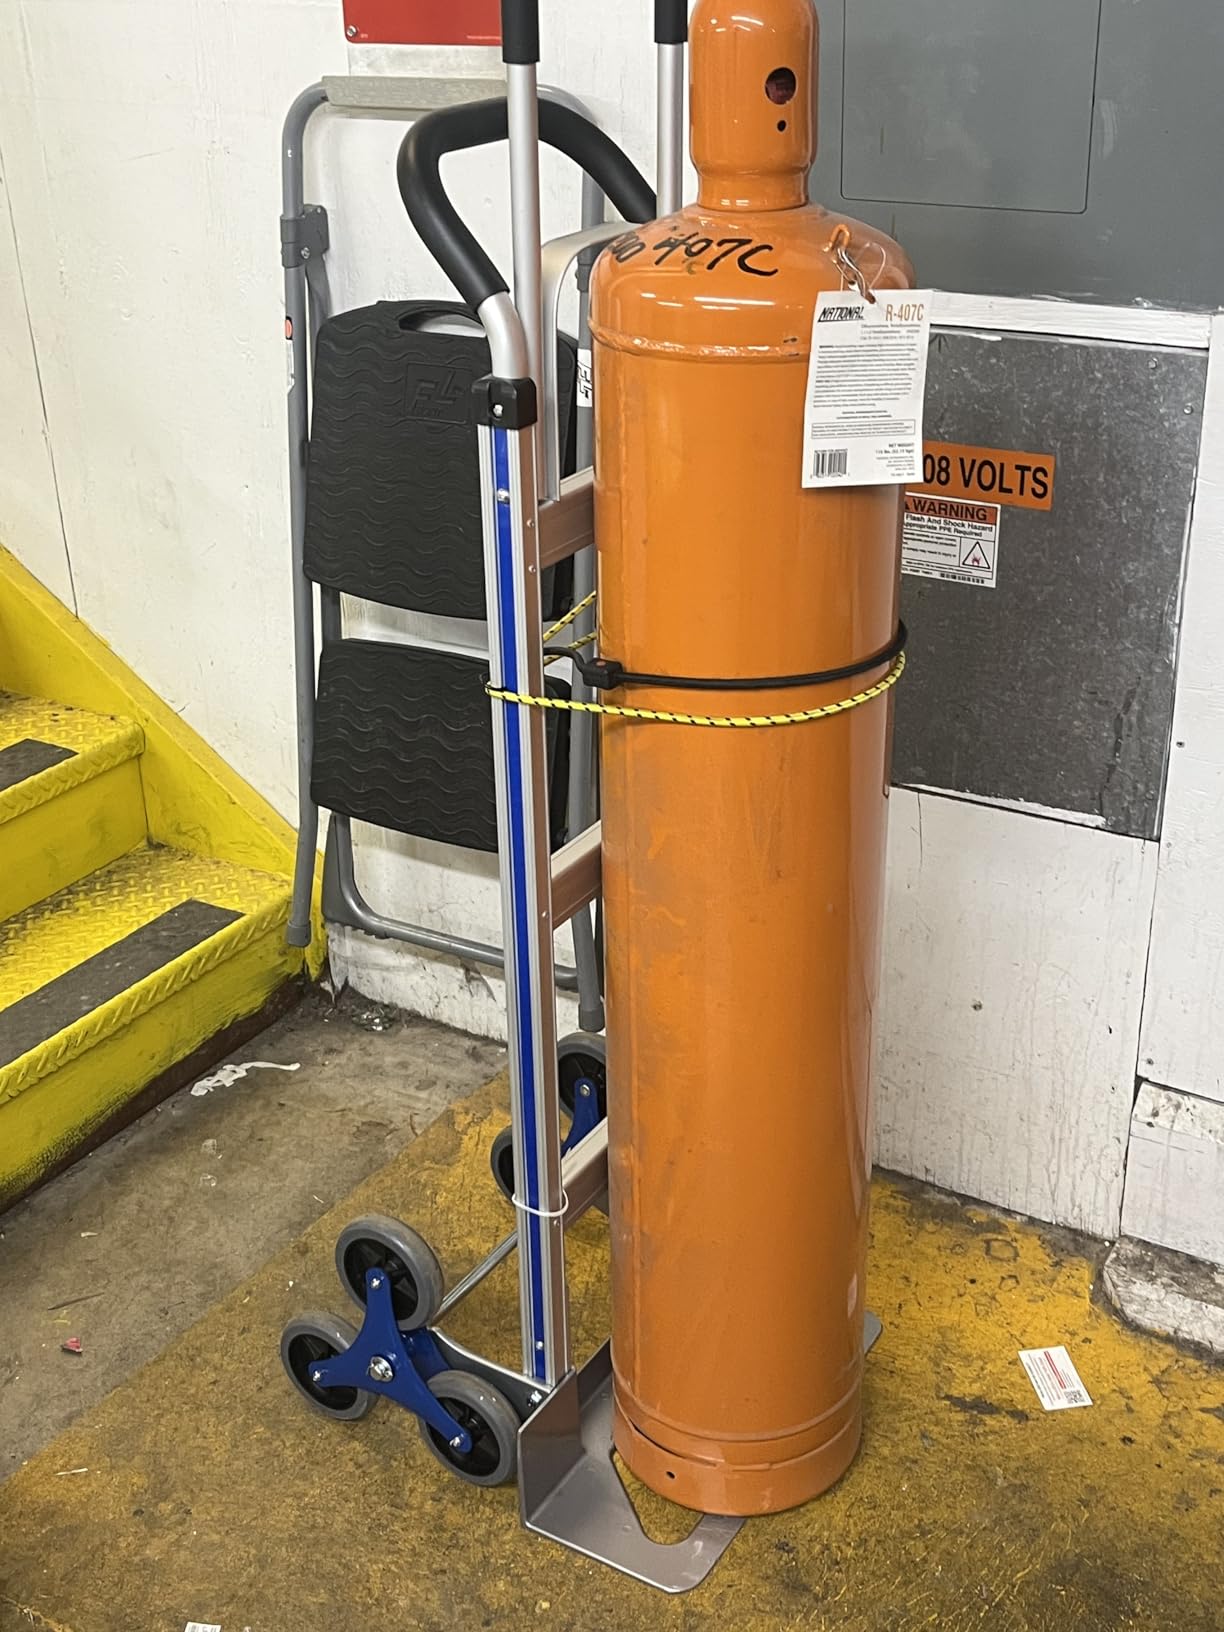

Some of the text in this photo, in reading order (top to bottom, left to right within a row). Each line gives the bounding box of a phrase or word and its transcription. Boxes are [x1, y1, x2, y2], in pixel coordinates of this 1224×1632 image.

[653, 232, 779, 276] 407C
[817, 306, 865, 323] NATIONAL
[885, 303, 925, 321] R-407C
[923, 453, 951, 486] 08
[959, 457, 1049, 500] VOLTS
[912, 498, 987, 520] WARNING
[904, 522, 937, 531] ppropriate
[939, 525, 952, 533] PPE
[954, 528, 983, 538] Required
[905, 514, 993, 532] Flash And Shock Hazard
